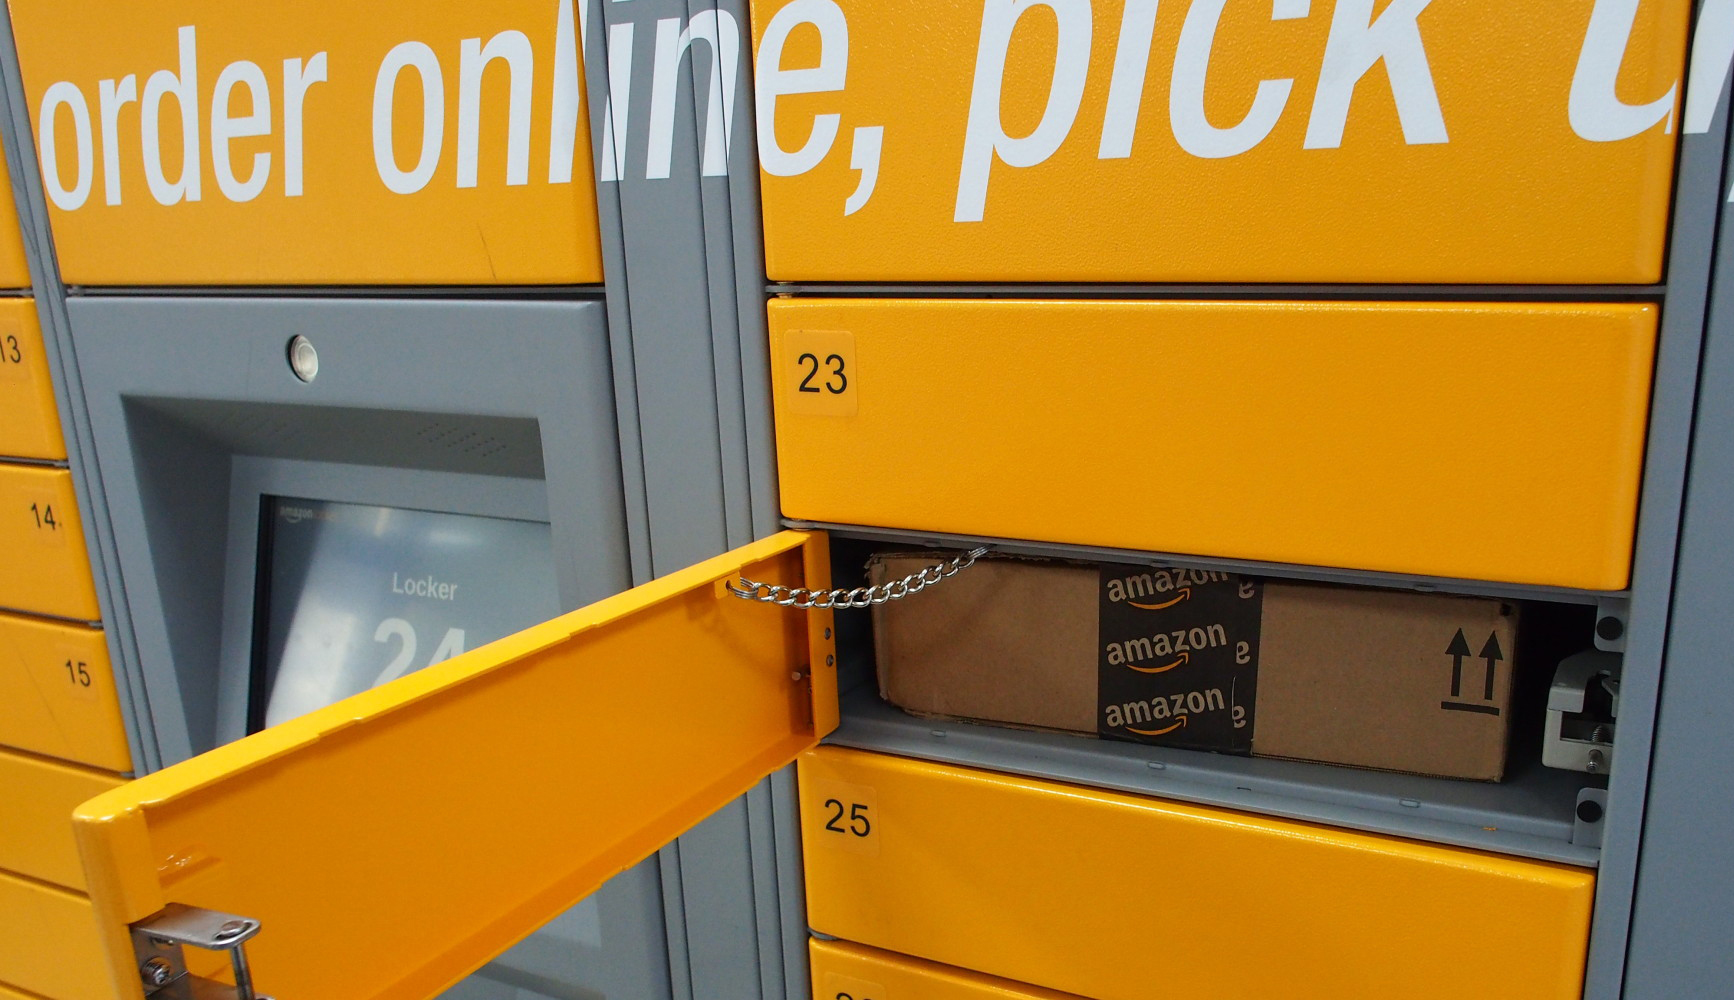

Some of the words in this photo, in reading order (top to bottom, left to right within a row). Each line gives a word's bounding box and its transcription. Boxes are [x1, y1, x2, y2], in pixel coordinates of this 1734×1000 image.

[39, 25, 328, 211] order
[372, 0, 884, 217] online,
[953, 0, 1449, 222] pick
[1568, 0, 1734, 203] u
[798, 353, 847, 394] 23
[31, 503, 56, 530] 14
[392, 572, 458, 600] Locker
[1106, 623, 1227, 665] amazon
[66, 660, 91, 687] 15
[1105, 688, 1225, 727] amazon
[824, 799, 870, 837] 25
